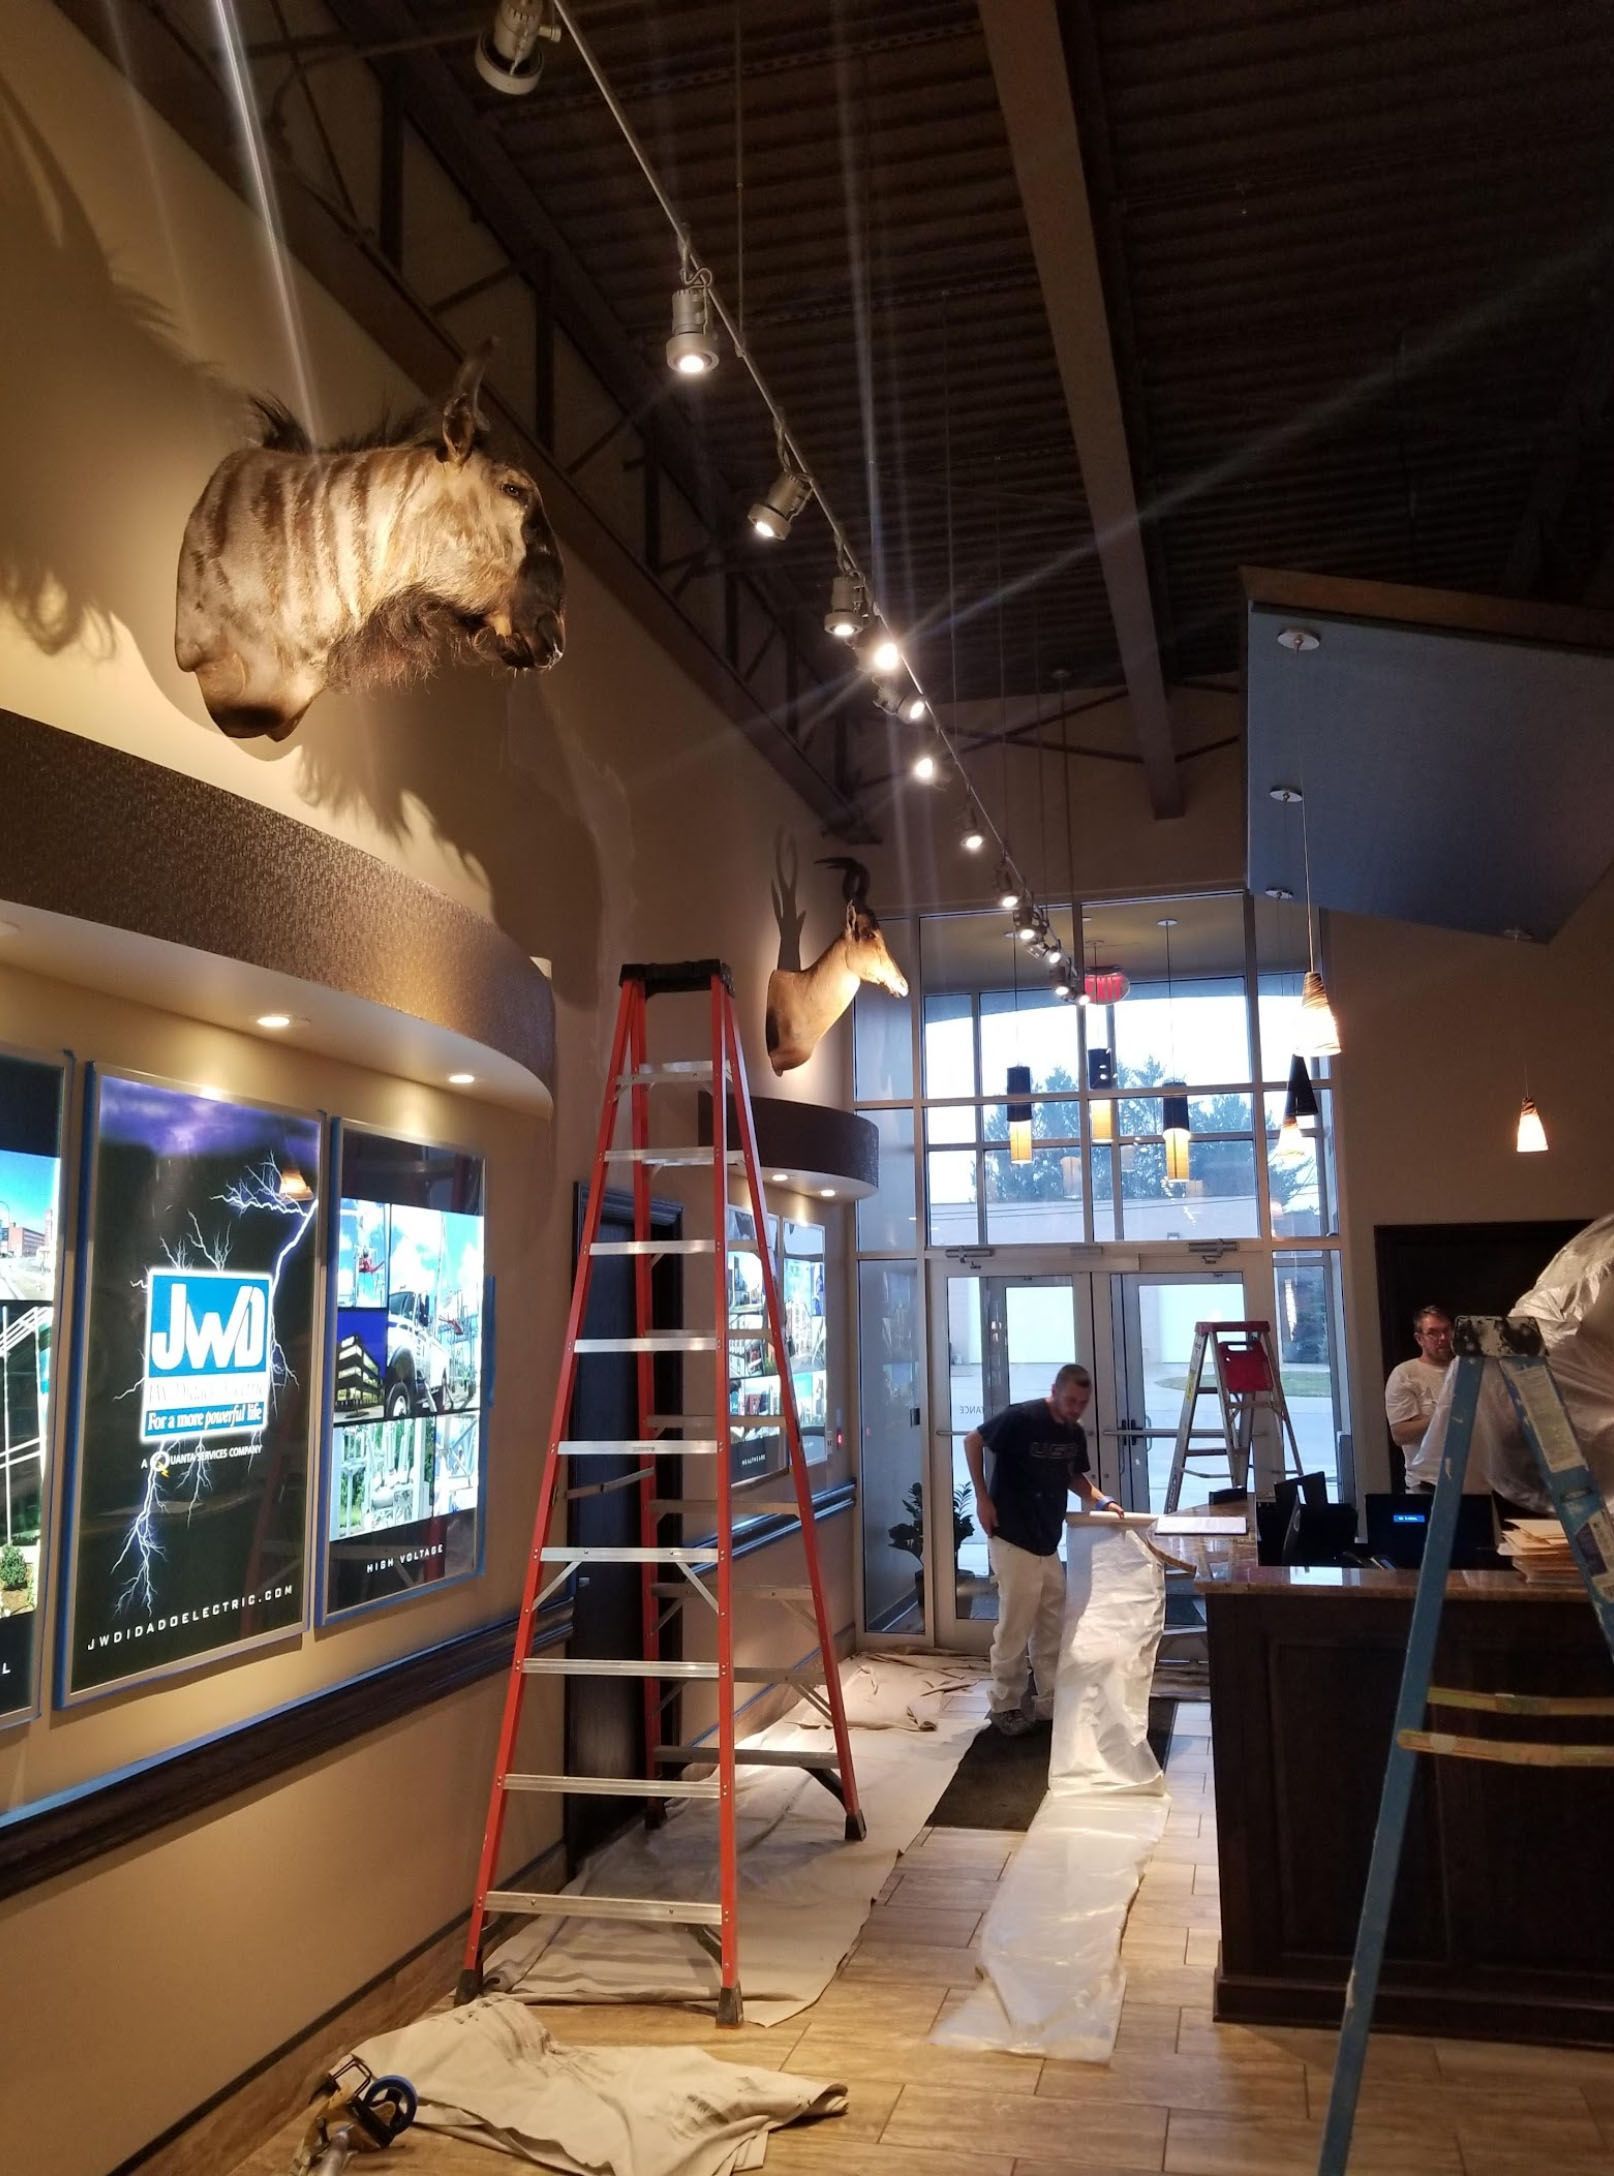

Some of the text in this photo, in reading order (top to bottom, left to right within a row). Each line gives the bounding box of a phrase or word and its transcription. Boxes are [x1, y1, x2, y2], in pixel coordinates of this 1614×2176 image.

[151, 1283, 266, 1370] JWD
[148, 1402, 262, 1431] For a more powerful life
[140, 1458, 148, 1469] A
[197, 1449, 227, 1461] SERVICES
[229, 1444, 263, 1458] COMPANY
[366, 1543, 443, 1574] HIGH VOLTAGE
[87, 1584, 294, 1651] JWDIDADOELECTRIC.COM
